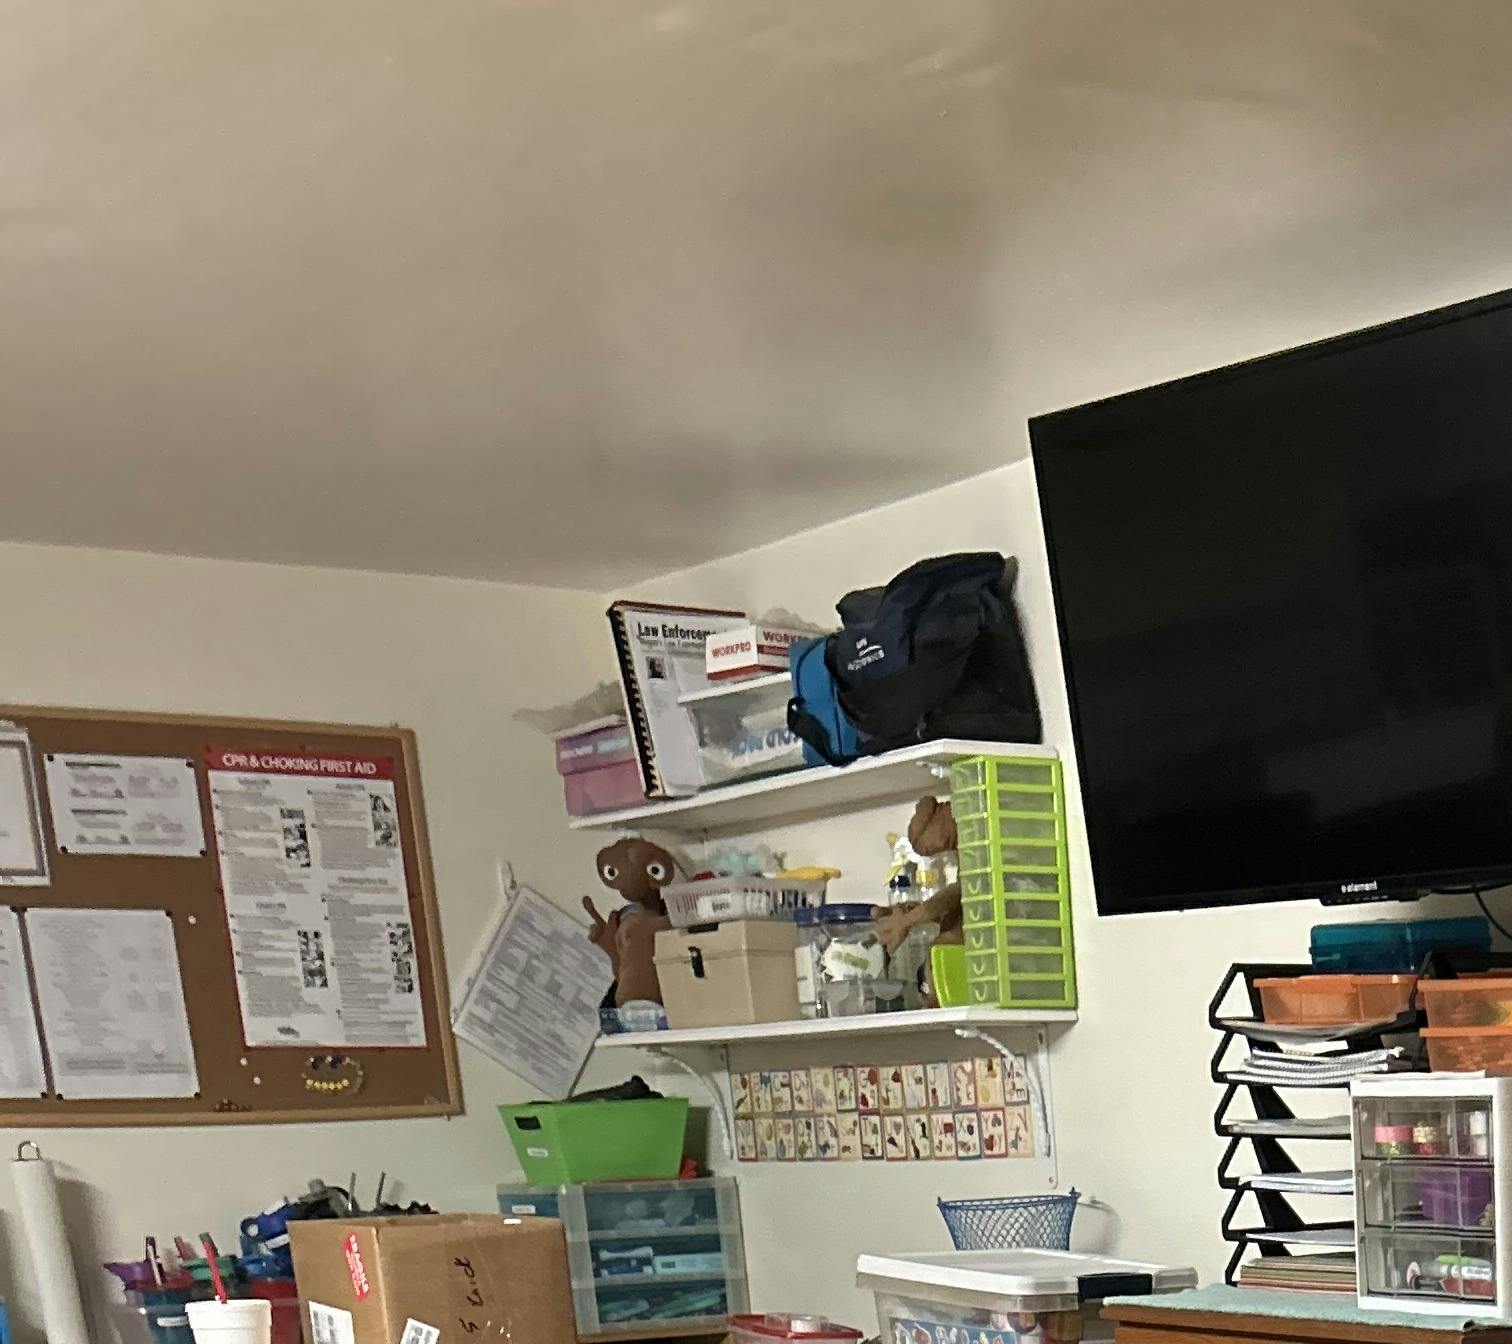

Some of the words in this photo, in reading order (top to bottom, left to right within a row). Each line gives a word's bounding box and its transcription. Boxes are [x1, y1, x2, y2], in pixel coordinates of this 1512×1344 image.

[637, 622, 659, 640] Law
[711, 640, 751, 658] WORKPRO
[222, 752, 248, 768] CPR
[249, 754, 260, 769] &
[261, 755, 319, 772] CHOKING
[320, 759, 352, 774] FIRST
[354, 761, 377, 775] AID
